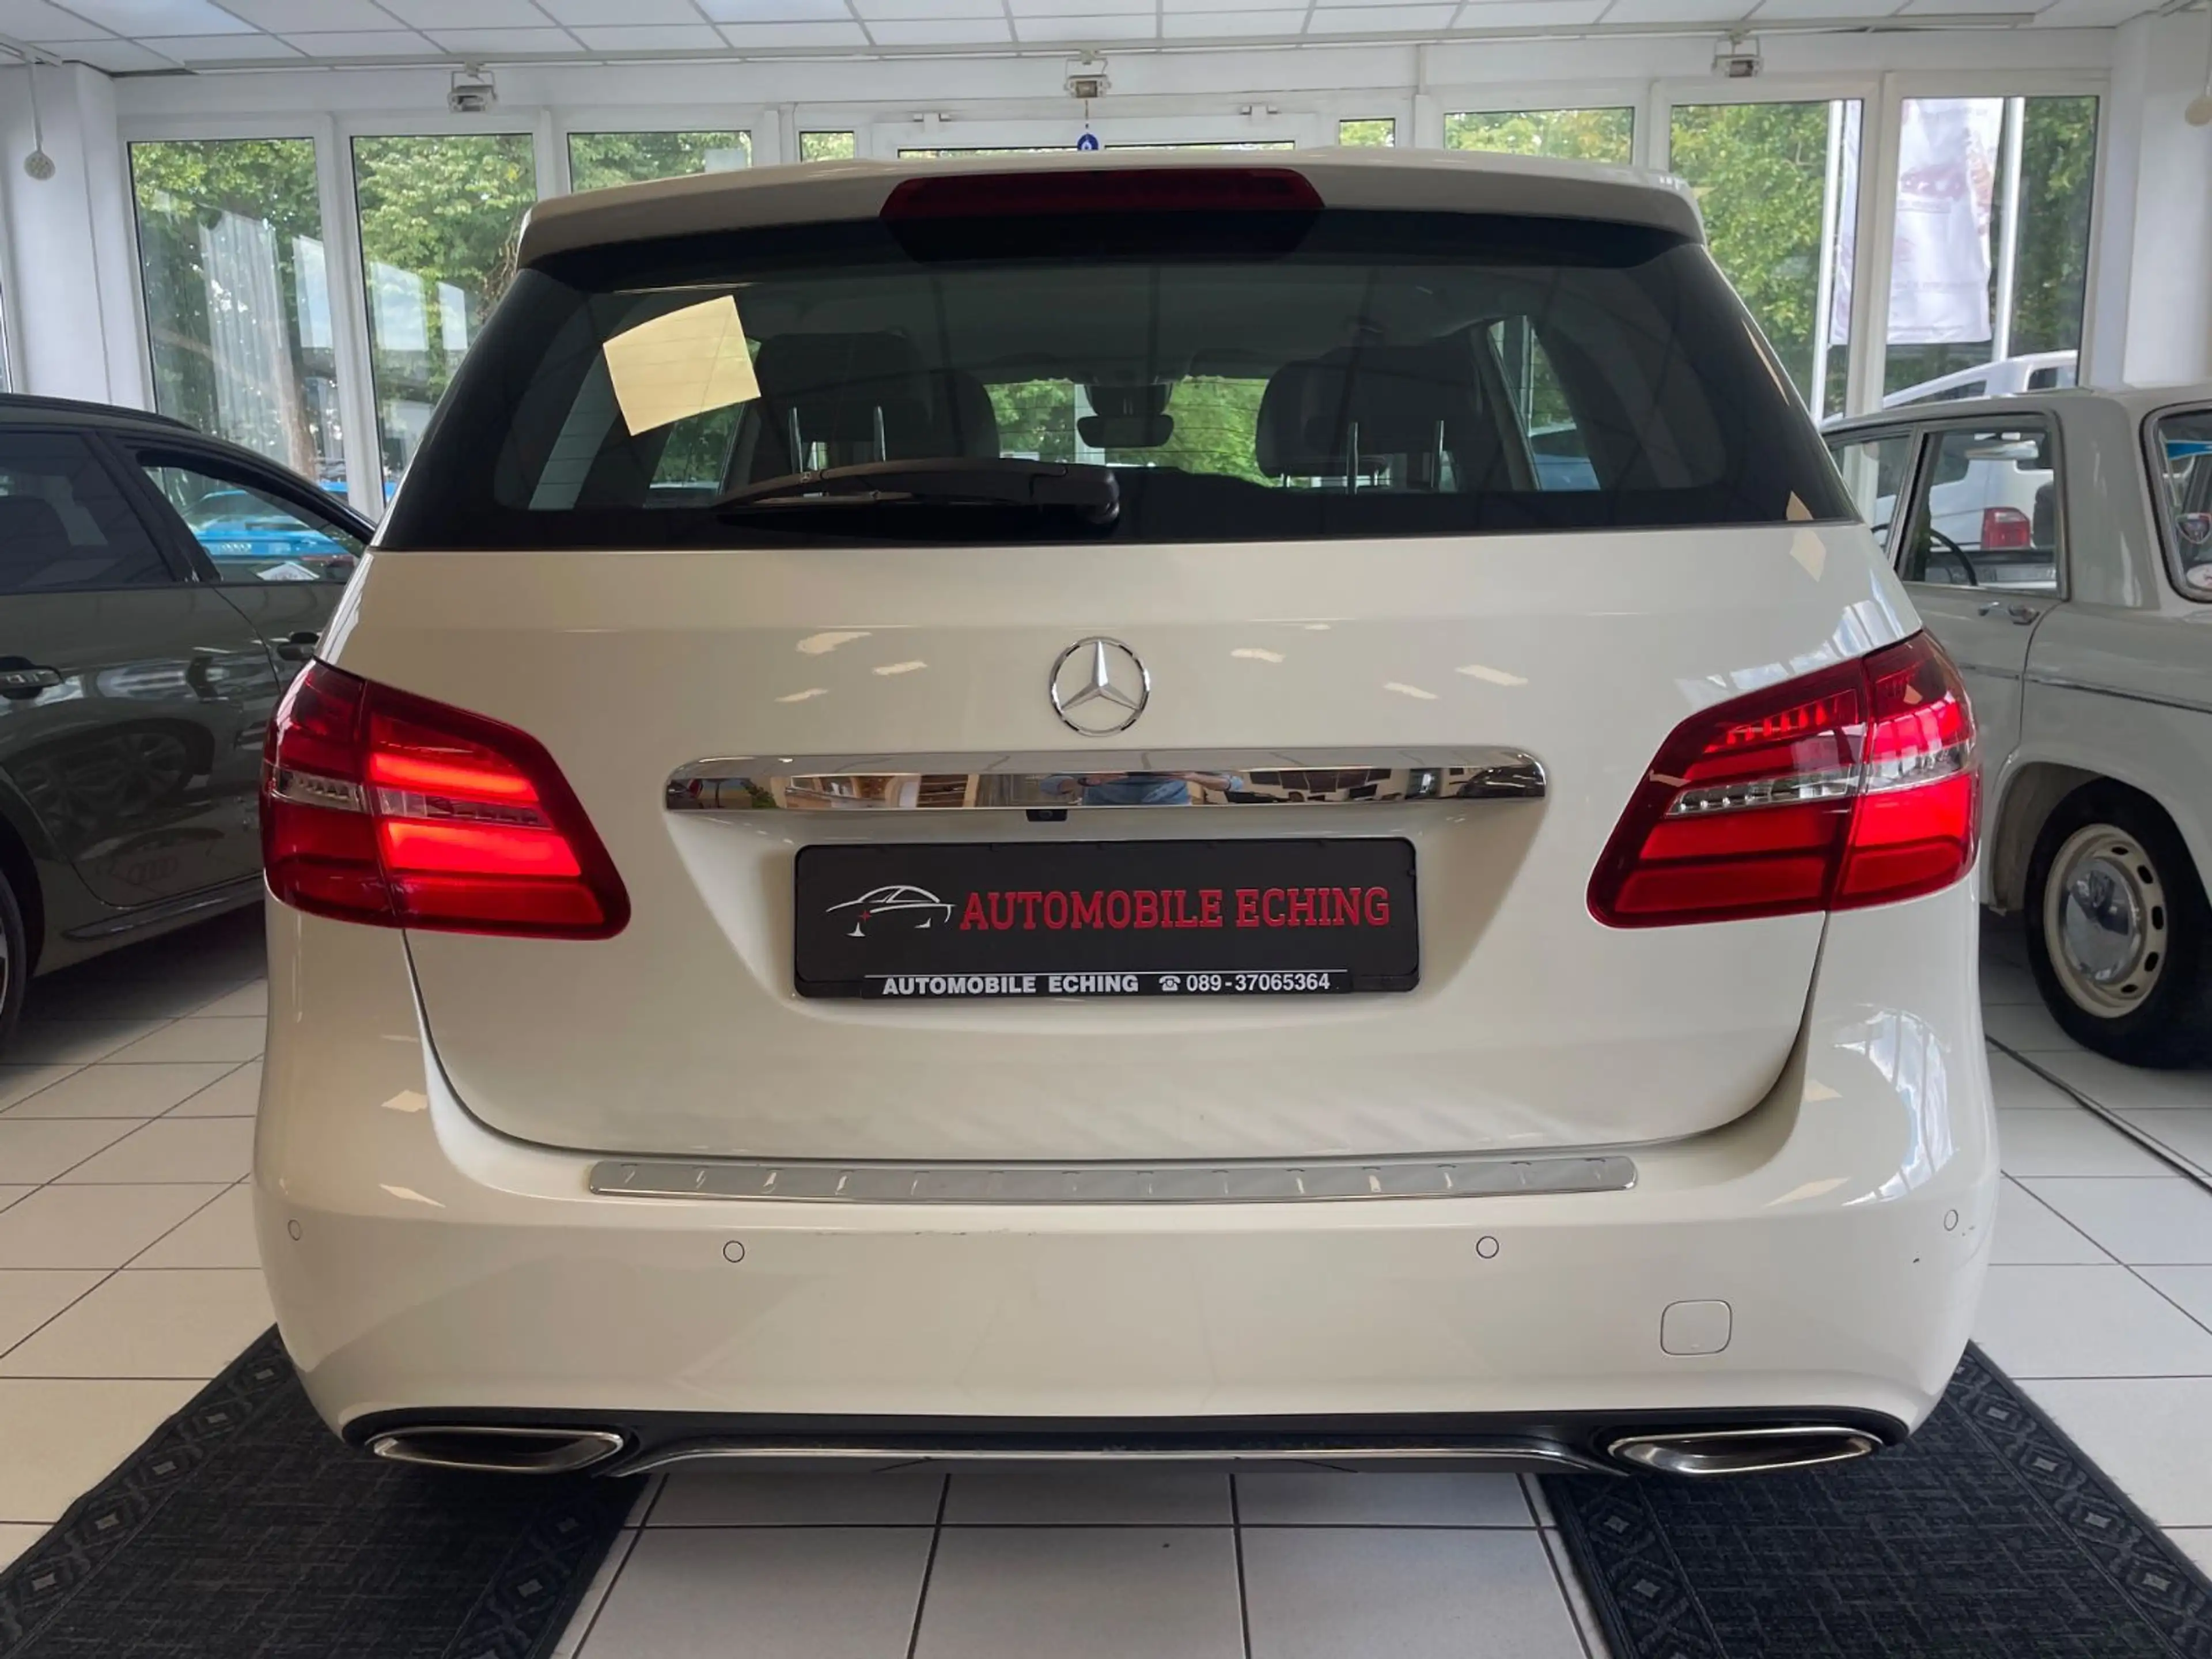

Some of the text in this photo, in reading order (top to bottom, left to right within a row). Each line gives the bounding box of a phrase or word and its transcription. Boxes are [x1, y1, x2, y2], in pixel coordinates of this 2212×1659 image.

[959, 887, 1391, 930] AUTOMOBILE ECHING
[882, 976, 1036, 995] AUTOMOBILE
[1048, 975, 1139, 993] ECHING
